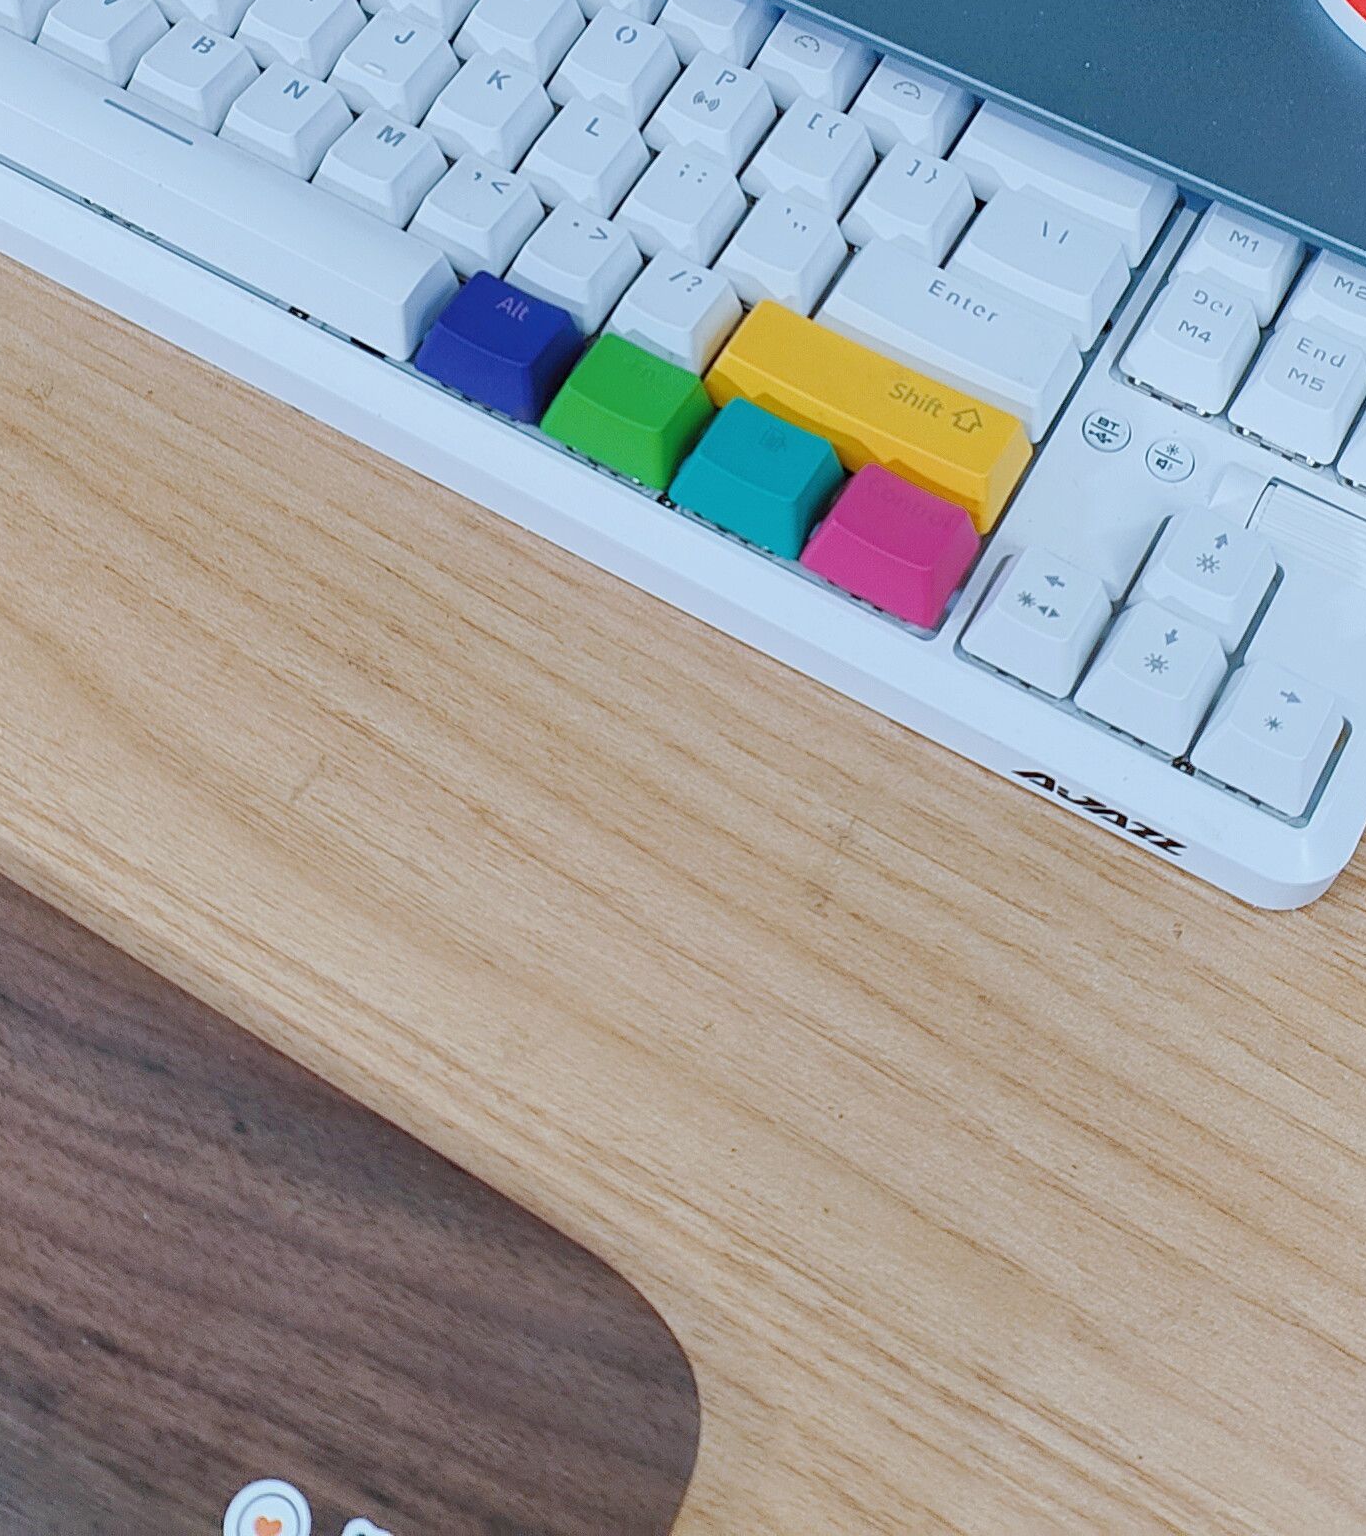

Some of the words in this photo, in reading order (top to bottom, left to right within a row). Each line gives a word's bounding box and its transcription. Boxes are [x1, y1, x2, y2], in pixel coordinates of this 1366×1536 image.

[191, 35, 216, 54] B
[394, 30, 416, 44] J
[283, 80, 310, 100] N
[486, 69, 511, 90] K
[715, 70, 737, 86] P
[376, 124, 407, 147] M
[585, 117, 600, 137] L
[1229, 229, 1261, 253] M1
[495, 295, 530, 322] Alt
[927, 278, 999, 323] Enter
[1192, 289, 1232, 317] Del
[1177, 319, 1212, 344] M4
[1296, 337, 1347, 369] End
[1287, 367, 1324, 392] M5
[888, 382, 944, 419] Shift
